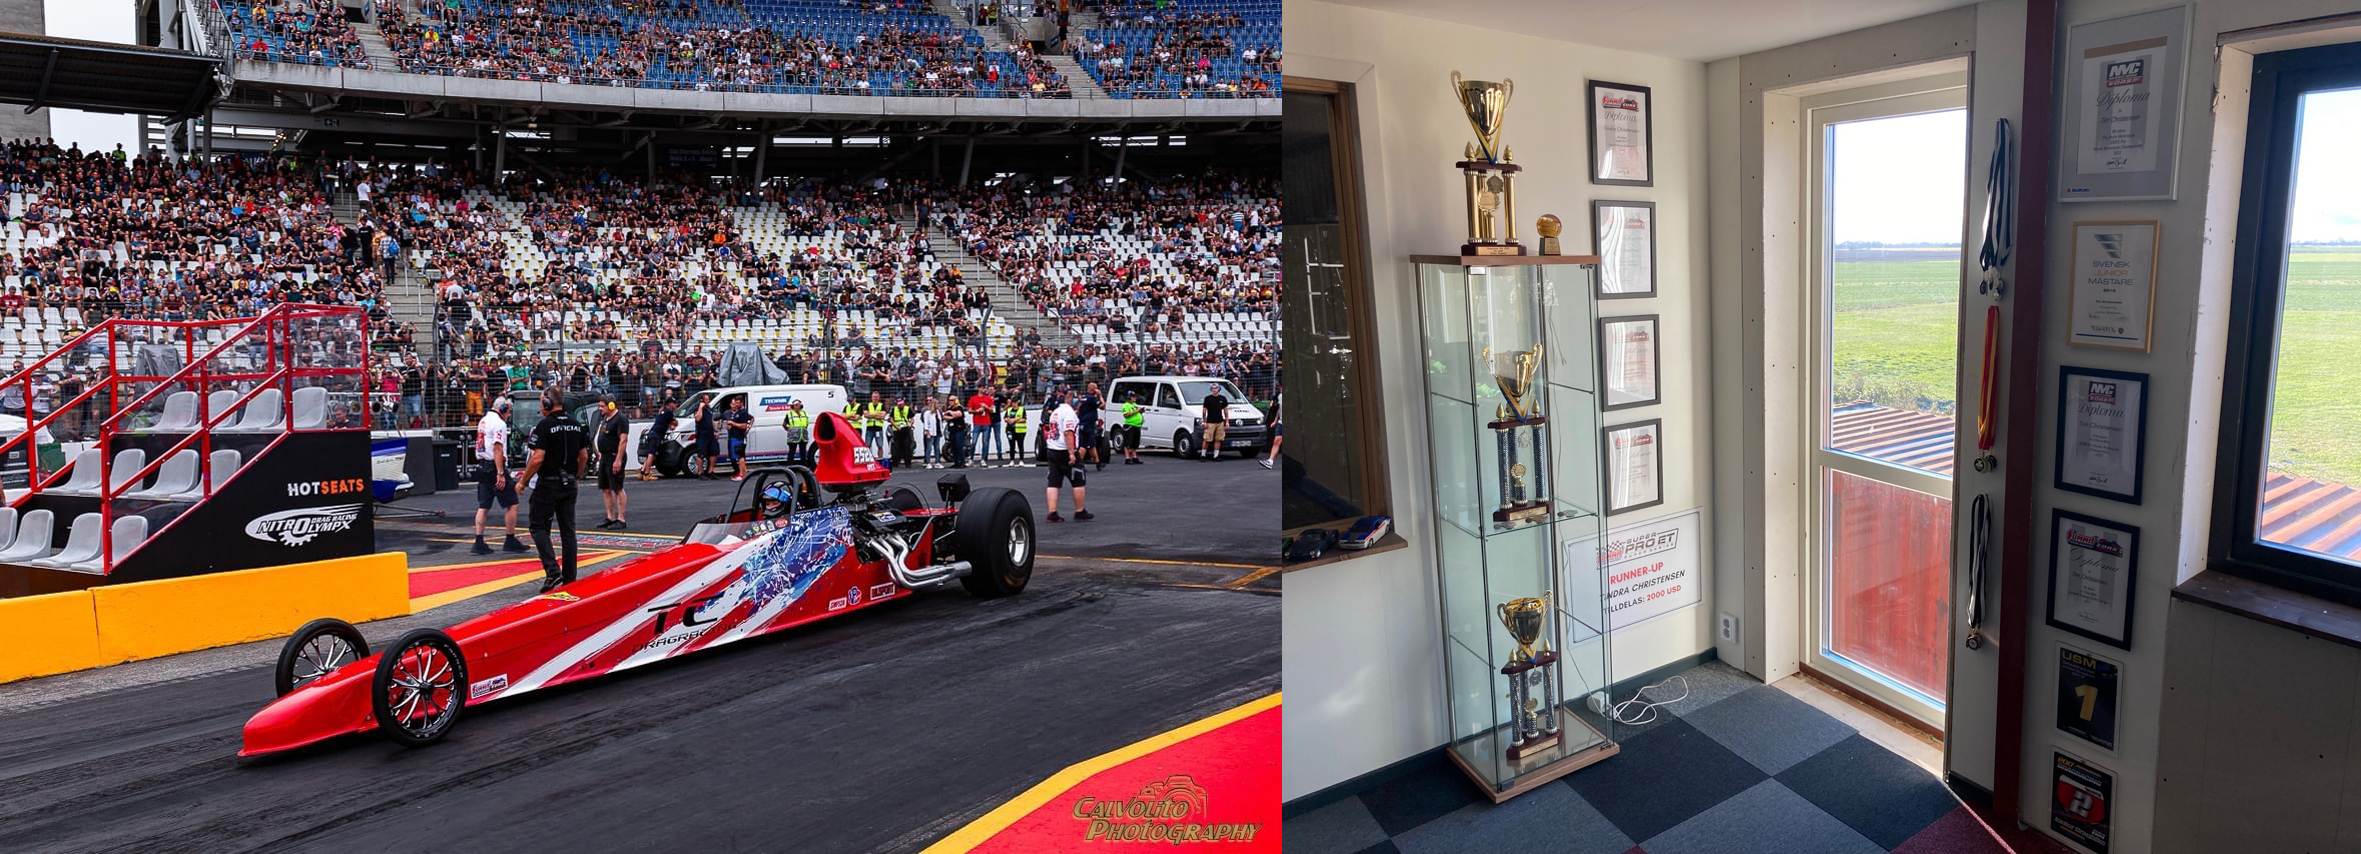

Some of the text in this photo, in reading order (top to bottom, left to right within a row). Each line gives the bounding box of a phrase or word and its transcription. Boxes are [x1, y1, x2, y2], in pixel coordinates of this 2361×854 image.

[2096, 88, 2151, 111] Diploma
[1604, 110, 1637, 122] Diploma
[2092, 260, 2130, 268] SVENSK
[2094, 269, 2128, 277] JUNIOR
[2079, 402, 2125, 419] Diploma
[550, 424, 581, 434] OFFICIAL
[311, 513, 358, 523] DRAG RACING
[1624, 532, 1675, 554] PRO ET
[1626, 532, 1657, 544] SUPER
[1610, 561, 1664, 585] RUNNER-UP
[1631, 569, 1685, 592] CHRISTENSEN
[1646, 589, 1665, 602] 2000
[1666, 584, 1682, 596] USD
[647, 591, 725, 635] TC
[2062, 650, 2097, 669] USM
[2074, 684, 2098, 721] 1
[2069, 790, 2093, 818] 2
